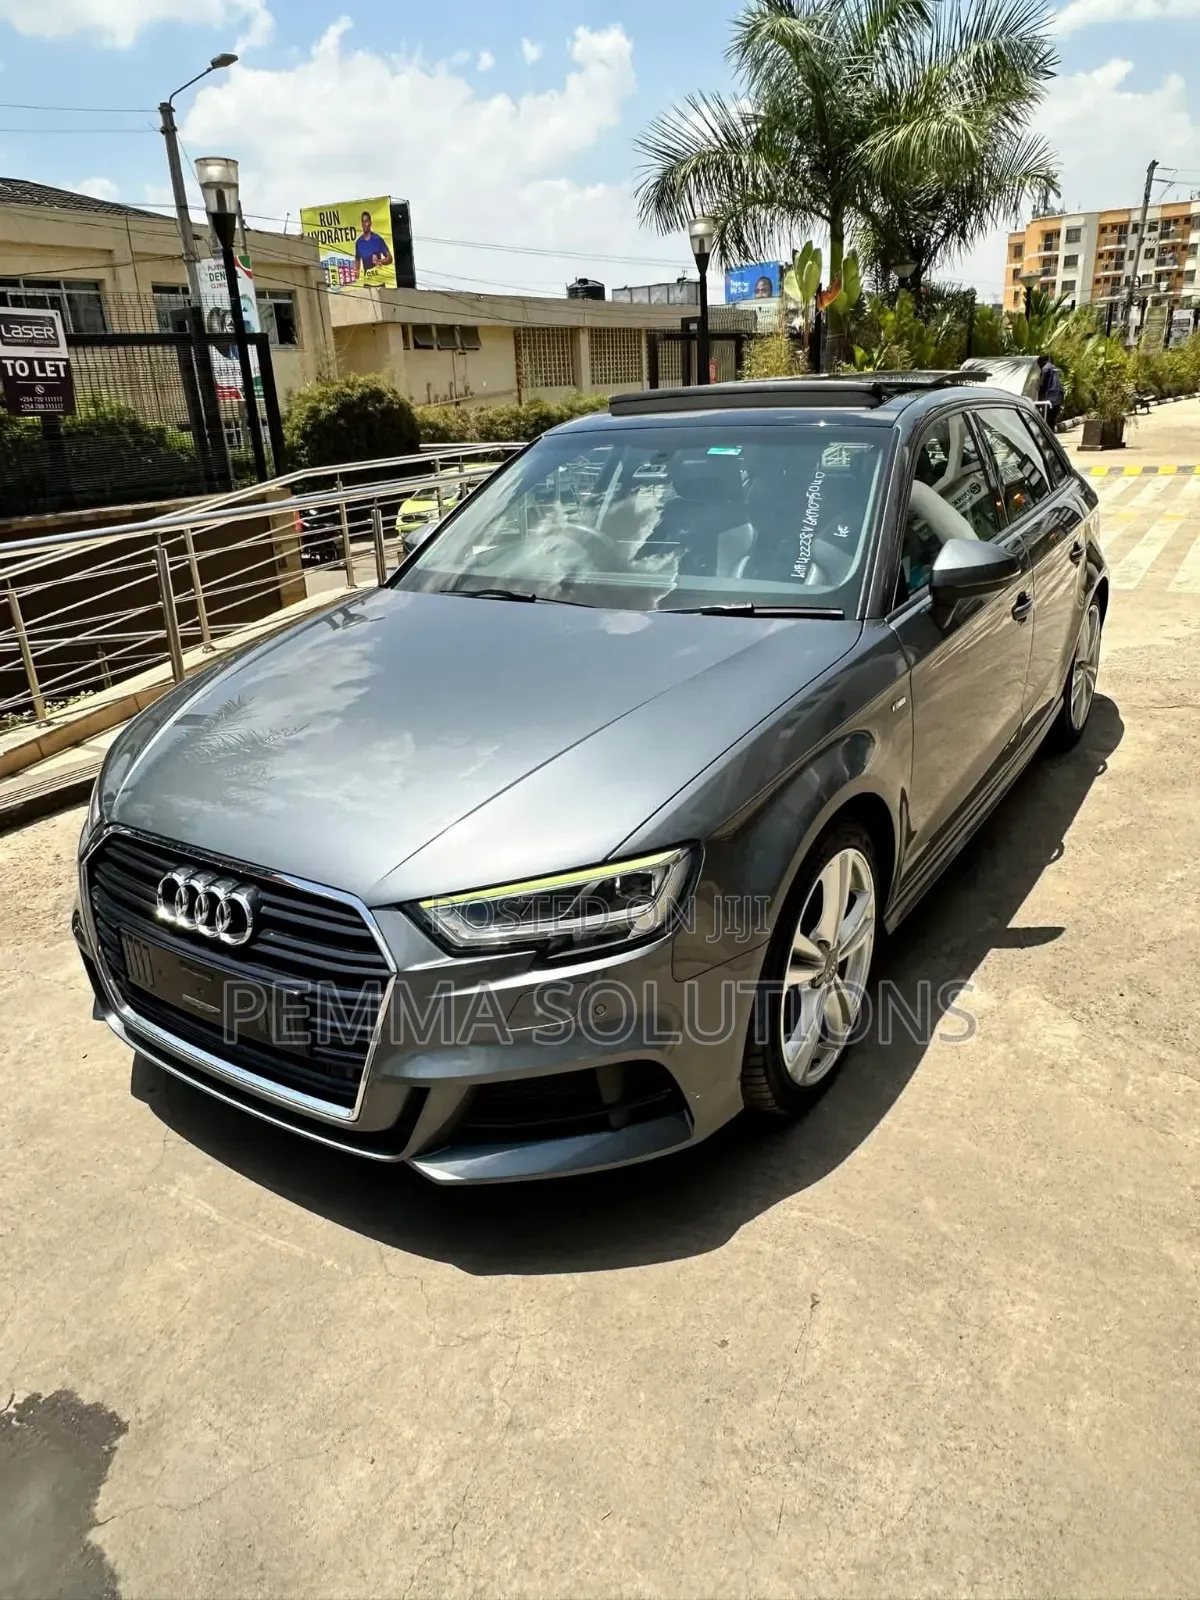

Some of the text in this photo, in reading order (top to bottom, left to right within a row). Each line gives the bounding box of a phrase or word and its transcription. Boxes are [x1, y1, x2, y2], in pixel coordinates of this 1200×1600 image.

[319, 210, 341, 227] RUN
[211, 281, 228, 289] CLINIC
[2, 360, 67, 377] TO LET
